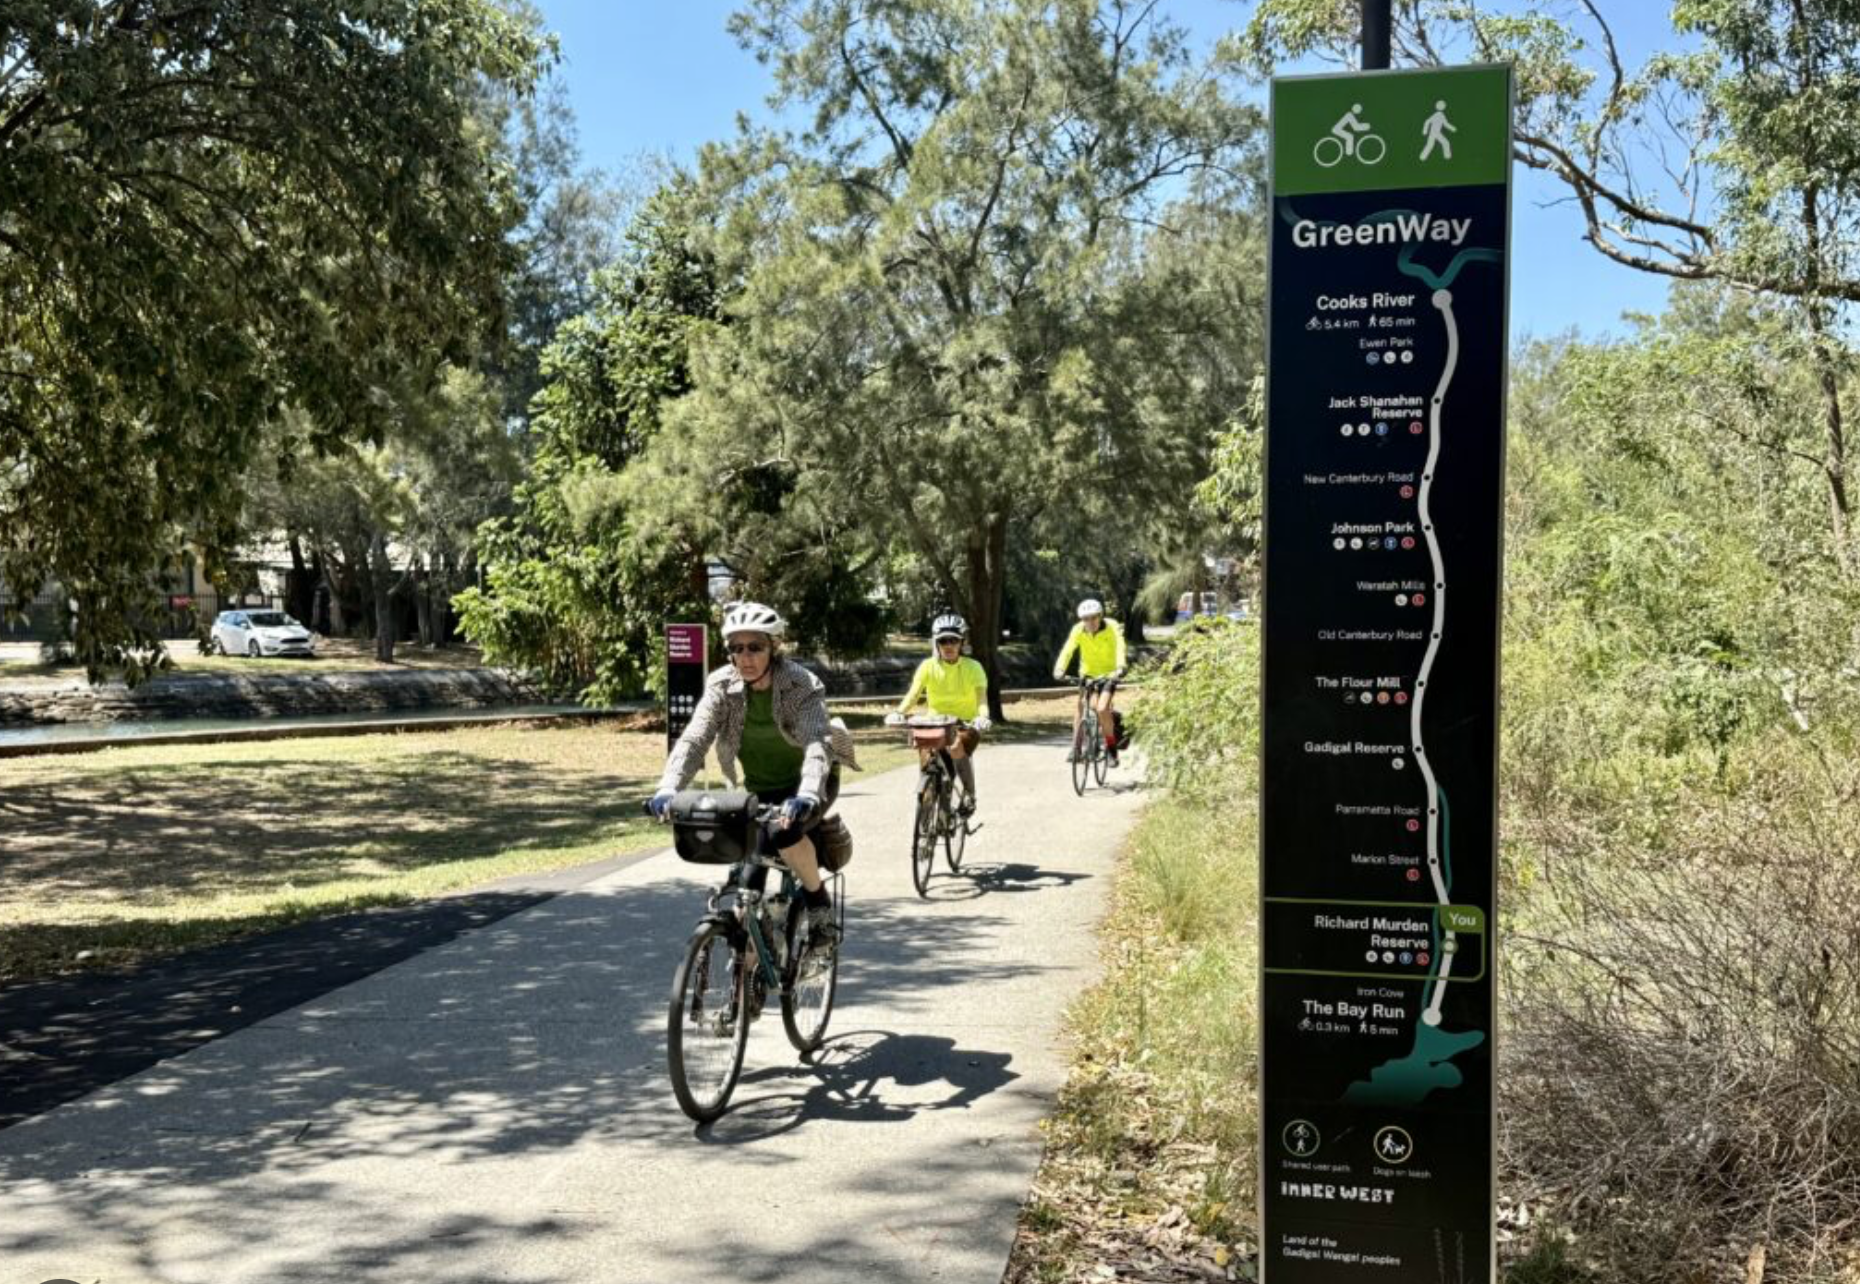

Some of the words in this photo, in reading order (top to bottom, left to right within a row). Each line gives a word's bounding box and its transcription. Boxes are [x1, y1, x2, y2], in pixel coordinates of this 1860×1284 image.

[1292, 213, 1471, 246] GreenWay
[1316, 294, 1368, 310] Cooks
[1373, 292, 1415, 309] River
[1323, 319, 1341, 330] 5.4
[1343, 318, 1360, 329] km
[1379, 316, 1394, 327] 65
[1395, 316, 1416, 327] min
[1359, 337, 1388, 349] Ewen
[1390, 336, 1414, 348] Park
[1328, 396, 1357, 409] Jack
[1360, 394, 1423, 407] Shanahan
[1371, 407, 1423, 419] Reserve
[1304, 473, 1327, 484] New
[1329, 472, 1385, 485] Canterbury
[1388, 471, 1415, 482] Road
[1331, 522, 1382, 534] Johnson
[1385, 522, 1415, 533] Park
[1356, 581, 1398, 591] Waratah
[1318, 629, 1336, 640] Old
[1338, 629, 1395, 641] Canterbury
[1397, 629, 1423, 640] Road
[1315, 676, 1340, 688] The
[1341, 676, 1374, 688] Flour
[1376, 676, 1401, 688] Mill
[1304, 741, 1352, 755] Gadigal
[1355, 741, 1405, 754] Reserve
[1335, 804, 1391, 815] Parramatta
[1393, 805, 1421, 816] Road
[1351, 853, 1386, 865] Marion
[1388, 854, 1420, 866] Street
[1314, 915, 1370, 930] Richard
[1372, 916, 1429, 932] Murden
[1449, 912, 1477, 926] You
[1371, 933, 1429, 948] Reserve
[1356, 986, 1377, 997] Iron
[1303, 999, 1334, 1015] The
[1337, 1001, 1368, 1019] Bay
[1372, 1003, 1406, 1019] Run
[1334, 1022, 1351, 1033] km
[1378, 1025, 1399, 1036] min
[1281, 1181, 1336, 1199] INNER
[1339, 1185, 1395, 1203] WEST
[1282, 1234, 1308, 1245] Land
[1308, 1236, 1320, 1246] of
[1321, 1238, 1338, 1248] the
[1323, 1250, 1360, 1263] Wangal
[1362, 1254, 1402, 1267] peoples
